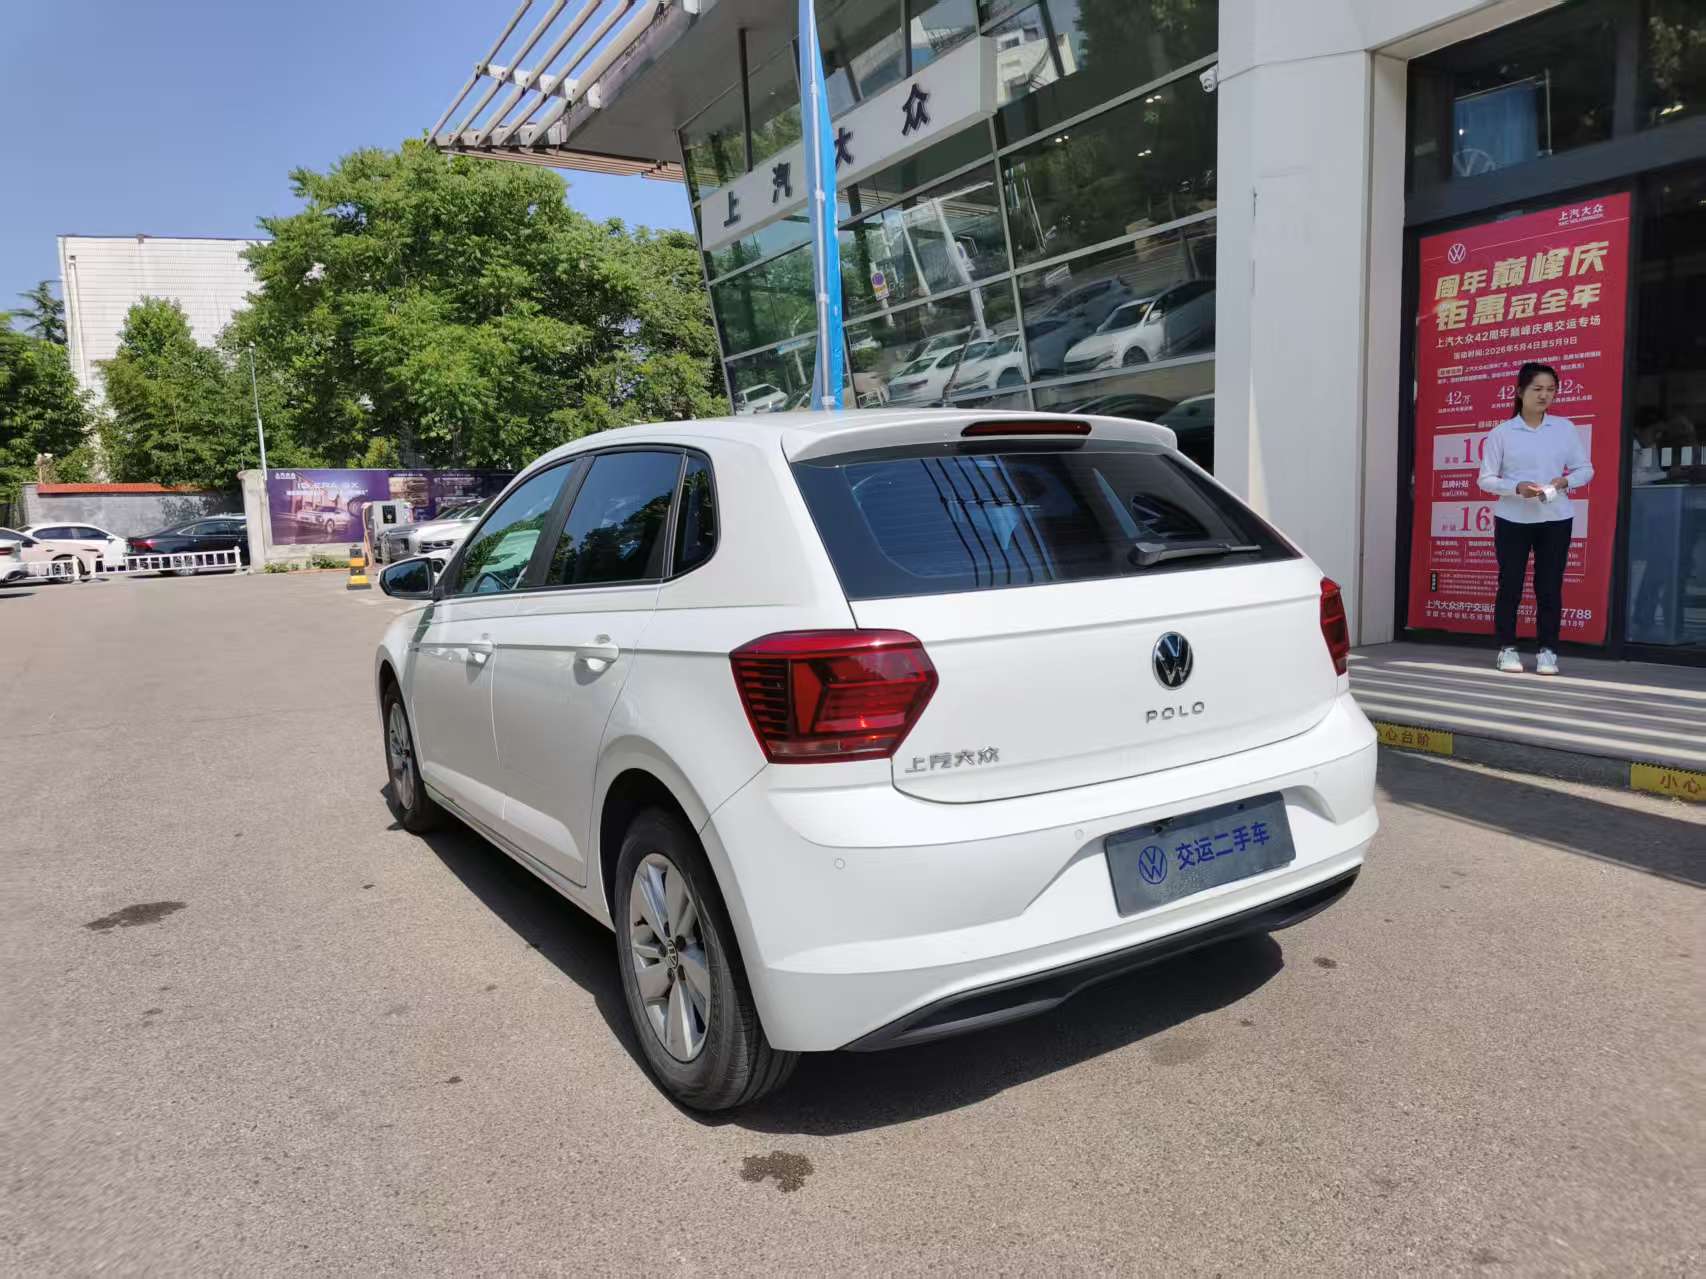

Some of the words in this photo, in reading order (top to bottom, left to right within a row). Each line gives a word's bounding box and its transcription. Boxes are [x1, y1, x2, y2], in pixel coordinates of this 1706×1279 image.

[1559, 204, 1604, 220] 上汽大众
[1435, 241, 1609, 300] 周年巅峰庆
[1561, 608, 1592, 619] 7788
[1145, 701, 1206, 723] POLO
[1378, 726, 1431, 745] 心台阶
[905, 746, 1000, 773] 上汽大众
[1660, 774, 1702, 794] 小心
[1175, 821, 1270, 871] 交运二手车
